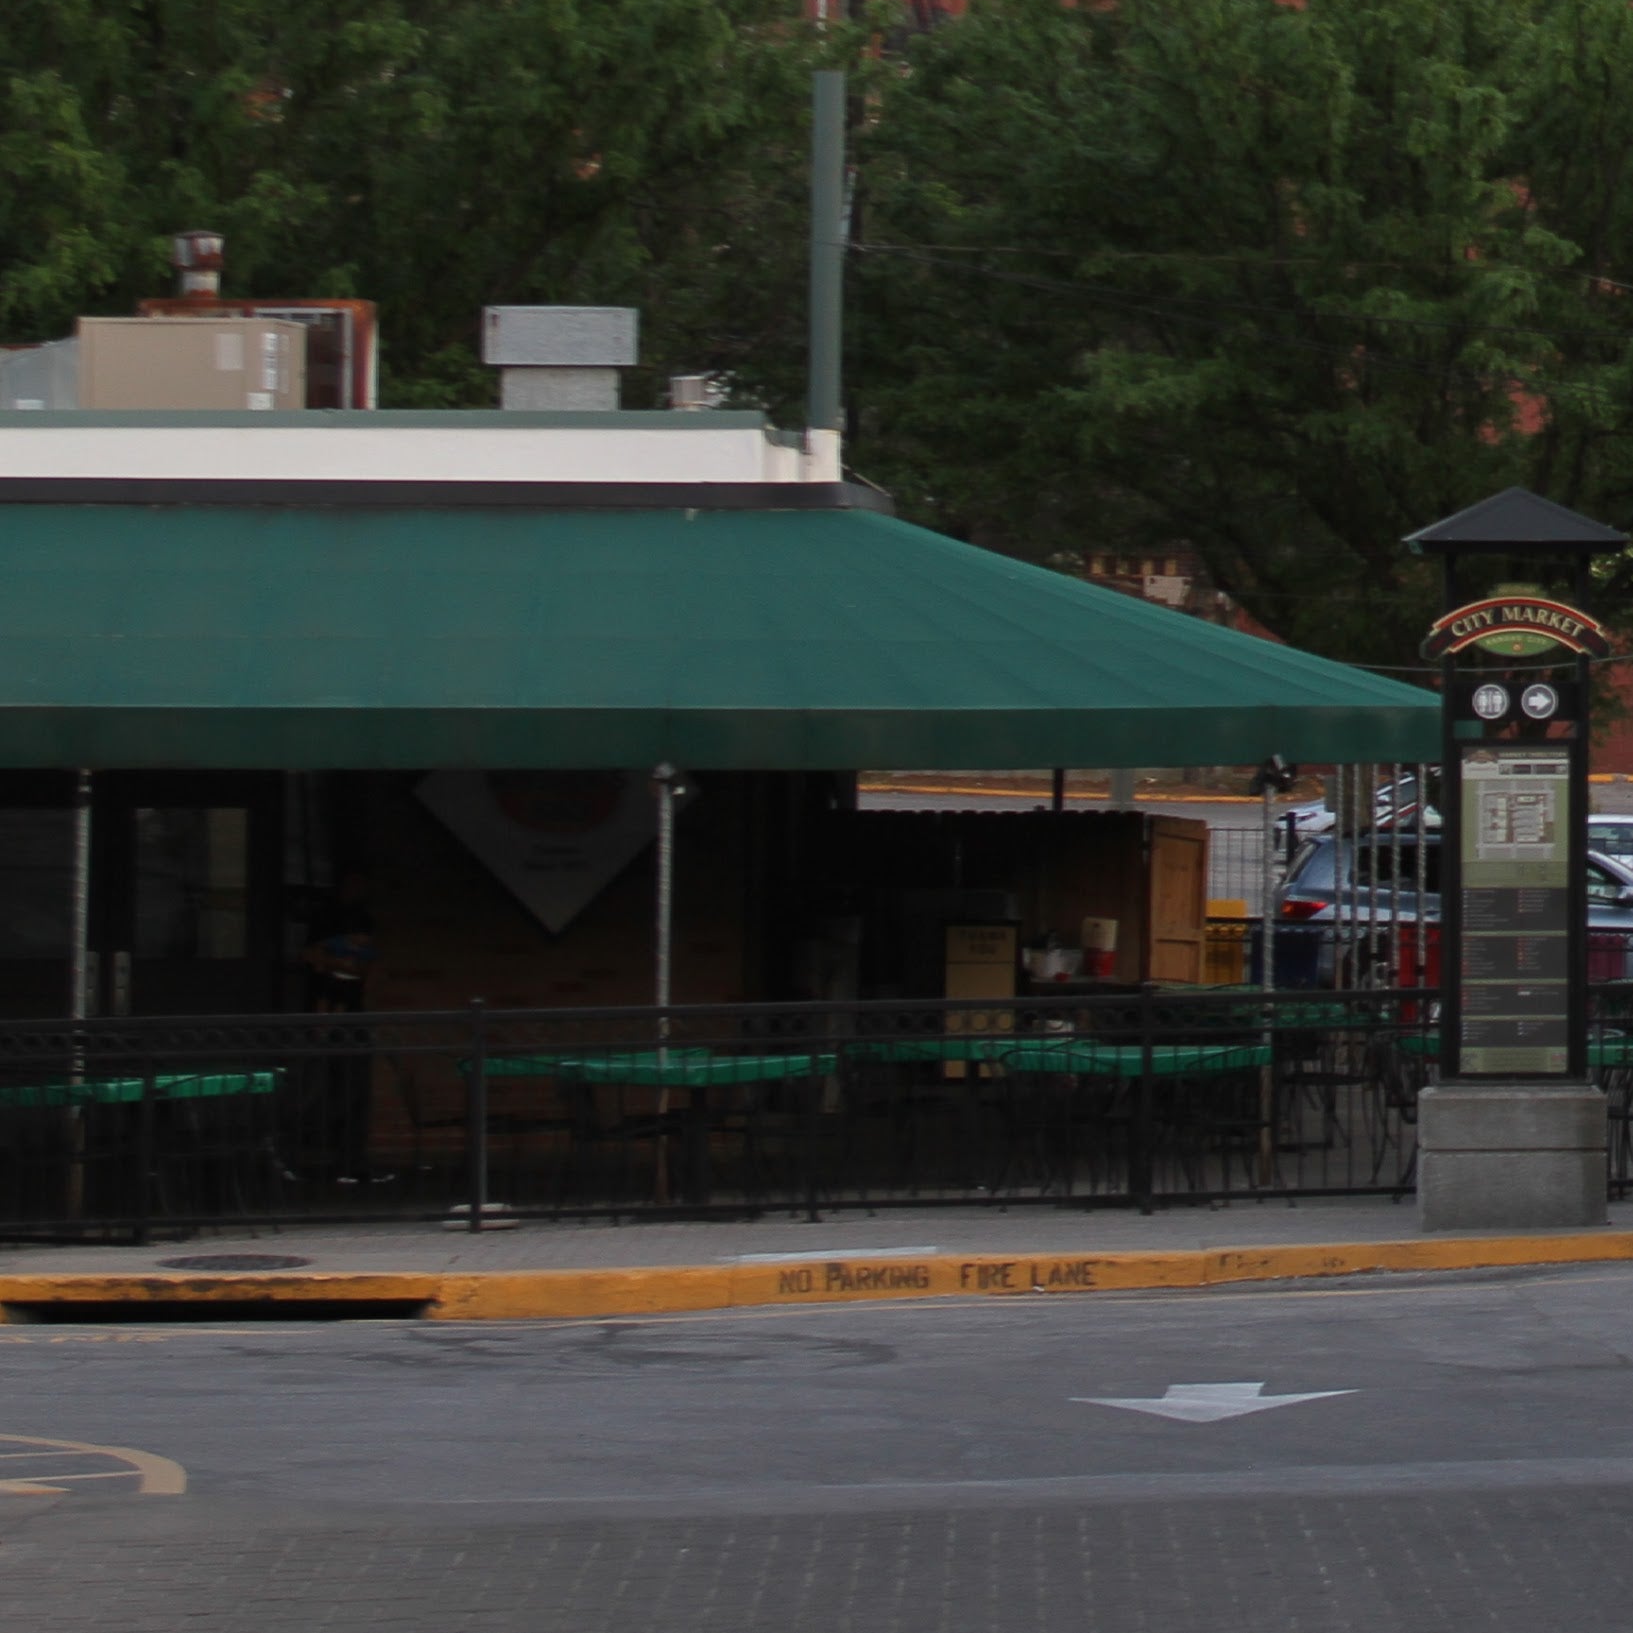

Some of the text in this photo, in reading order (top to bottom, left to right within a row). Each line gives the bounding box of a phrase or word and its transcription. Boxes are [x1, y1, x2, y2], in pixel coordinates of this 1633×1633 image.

[1451, 606, 1586, 637] CITY MARKET
[778, 1261, 1098, 1294] NO PARKING FIRE LANE
